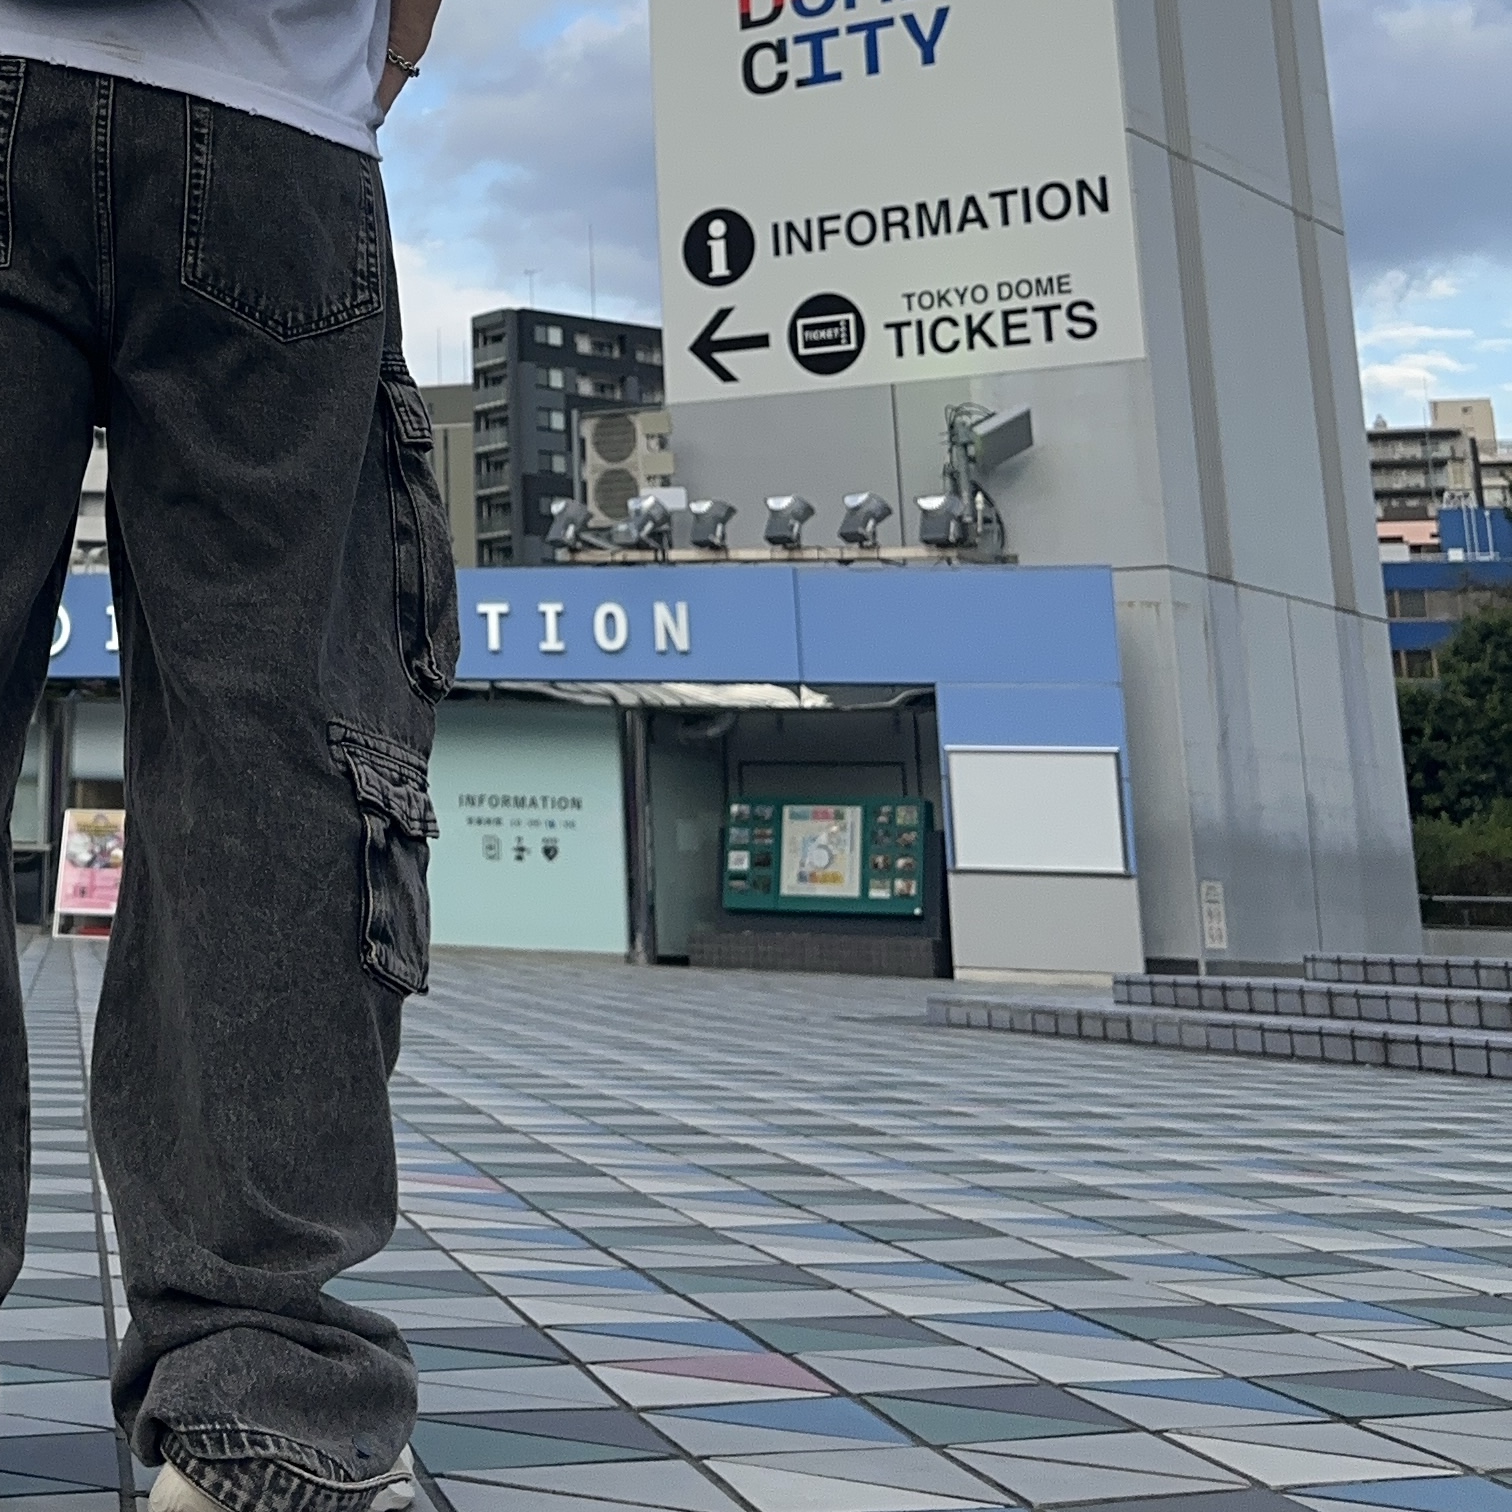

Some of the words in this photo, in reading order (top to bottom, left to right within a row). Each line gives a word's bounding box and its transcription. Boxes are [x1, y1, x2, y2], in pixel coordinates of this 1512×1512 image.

[741, 5, 951, 97] CITY
[771, 175, 1111, 258] INFORMATION
[901, 283, 990, 312] TOKYO
[996, 273, 1073, 303] DOME
[884, 299, 1099, 359] TICKETS
[458, 793, 583, 810] INFORMATION
